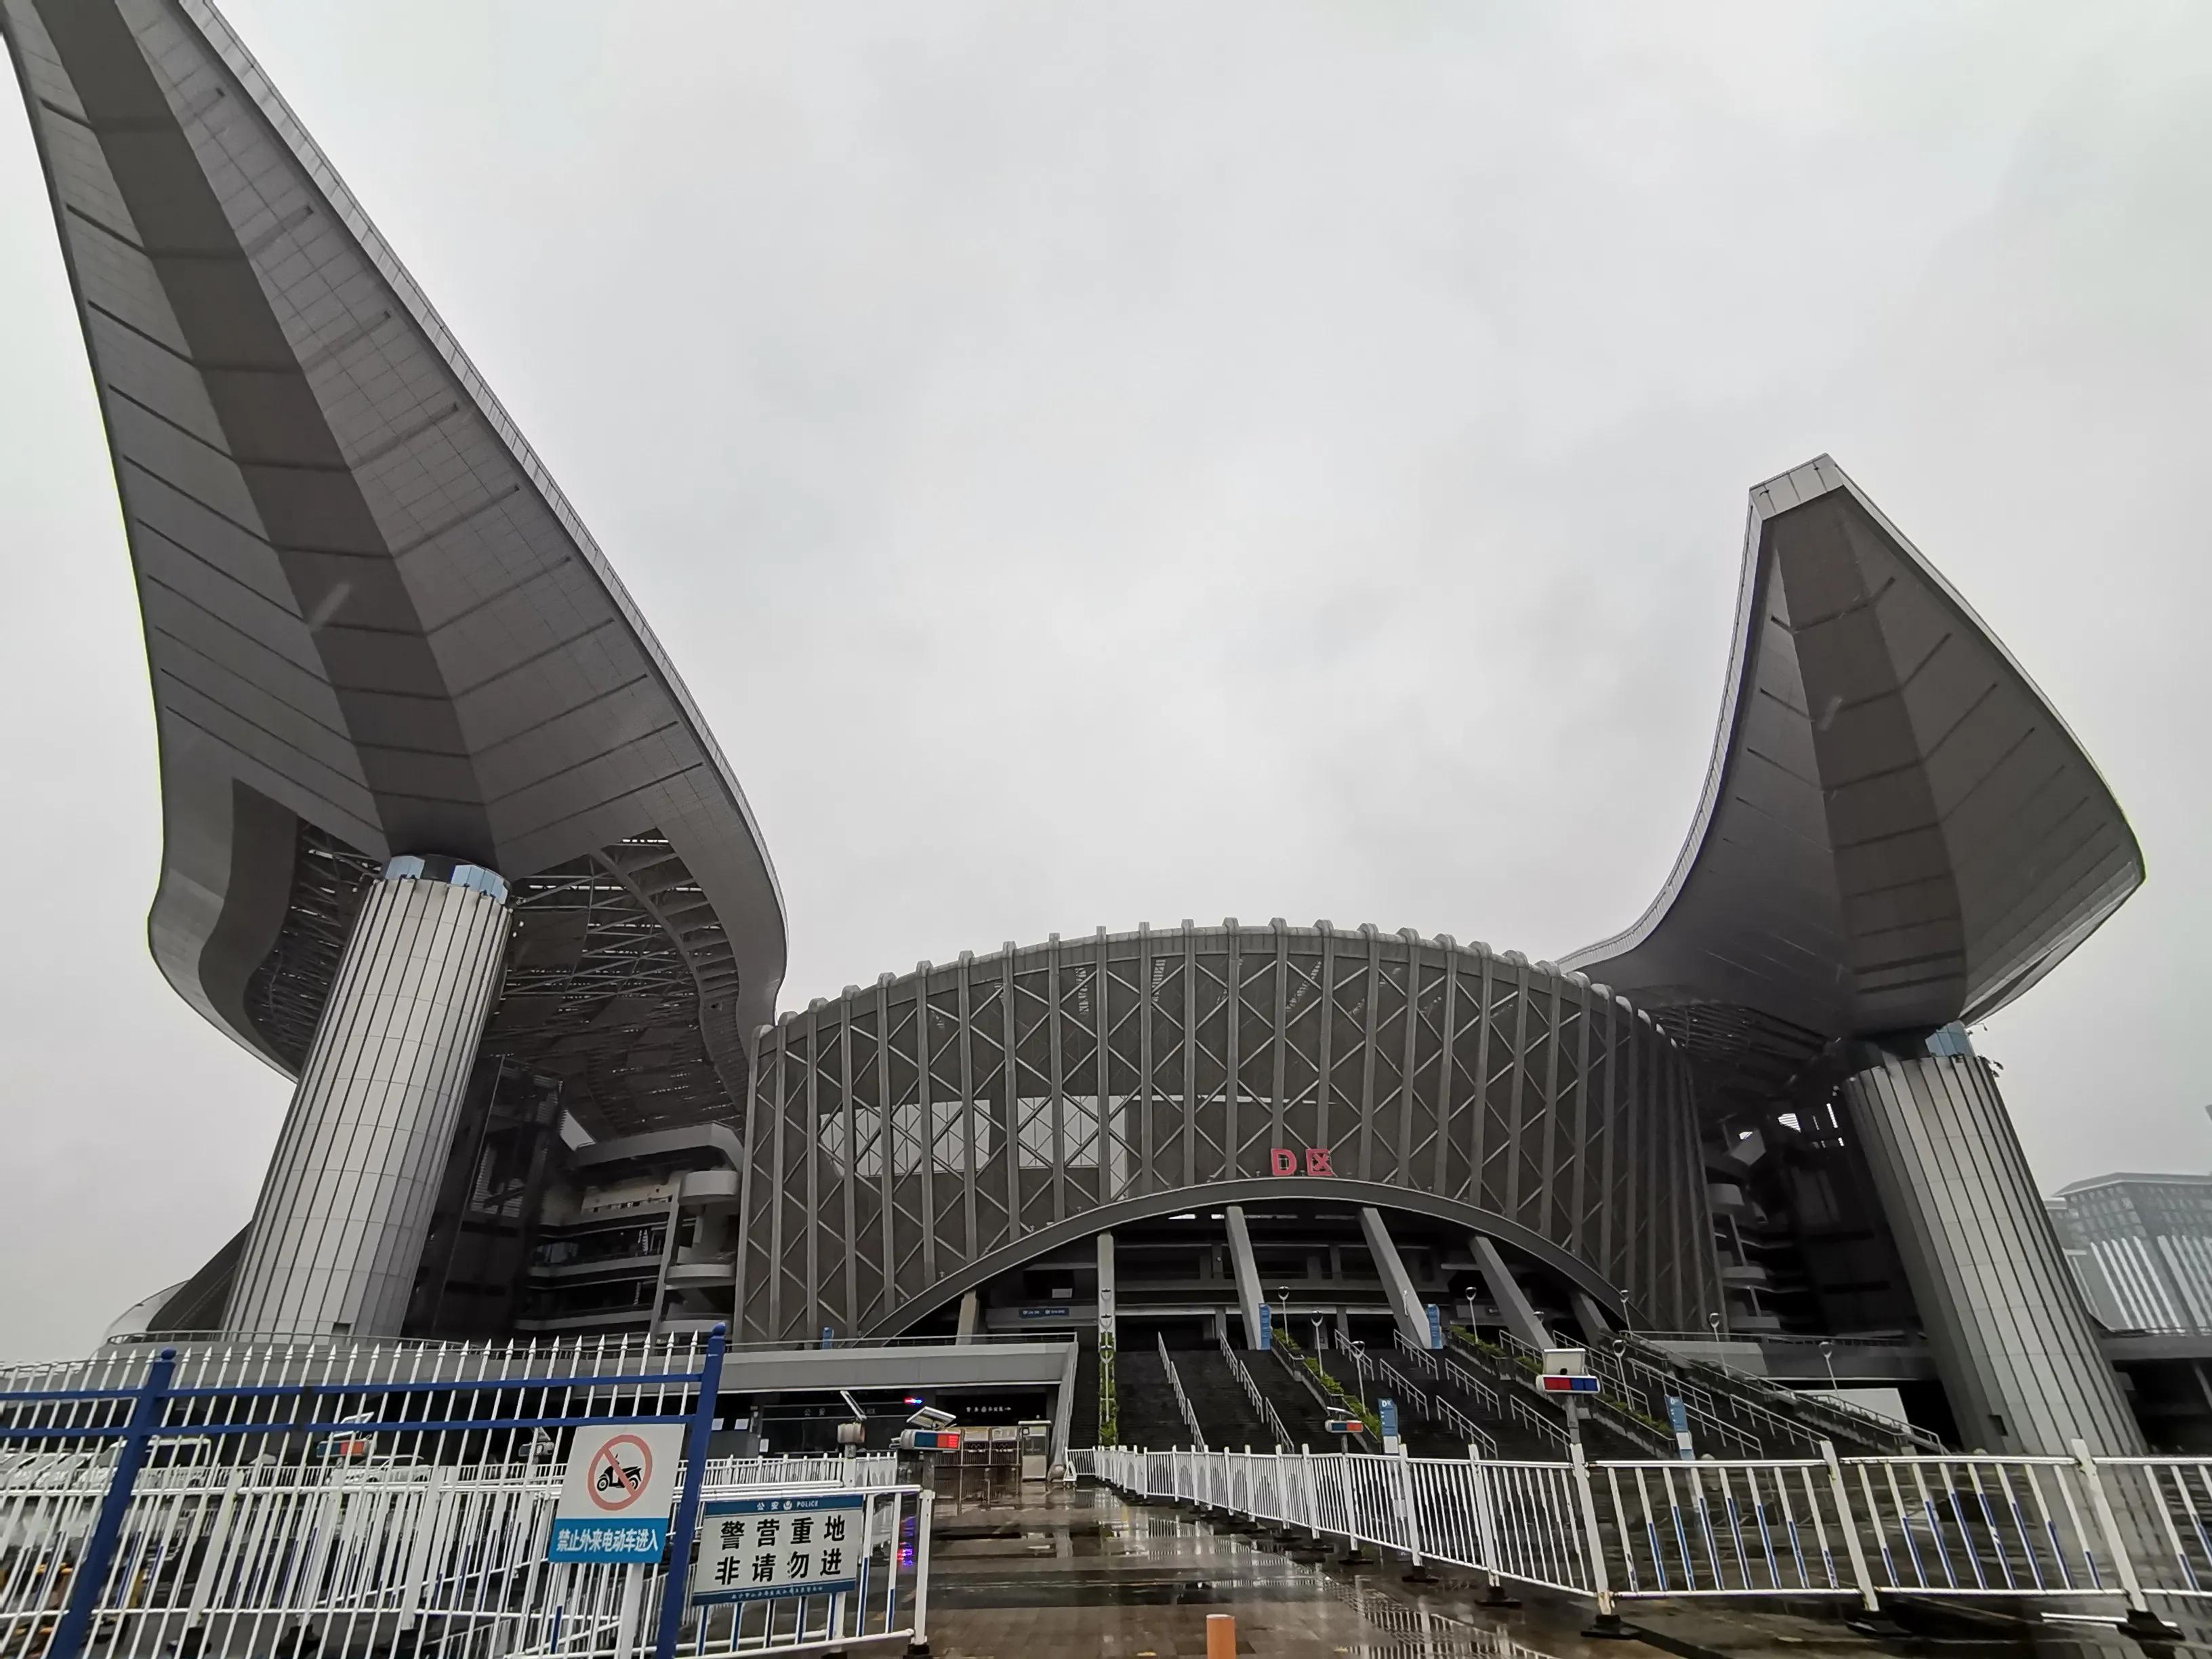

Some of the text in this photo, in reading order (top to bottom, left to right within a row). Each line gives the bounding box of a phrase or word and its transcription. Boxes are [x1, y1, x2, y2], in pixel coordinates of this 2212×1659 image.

[1271, 1148, 1334, 1176] D区
[756, 1501, 779, 1511] 公安
[556, 1528, 658, 1552] 禁止外来电动车进入
[720, 1515, 845, 1550] 警营重地
[715, 1548, 842, 1585] 非请勿进
